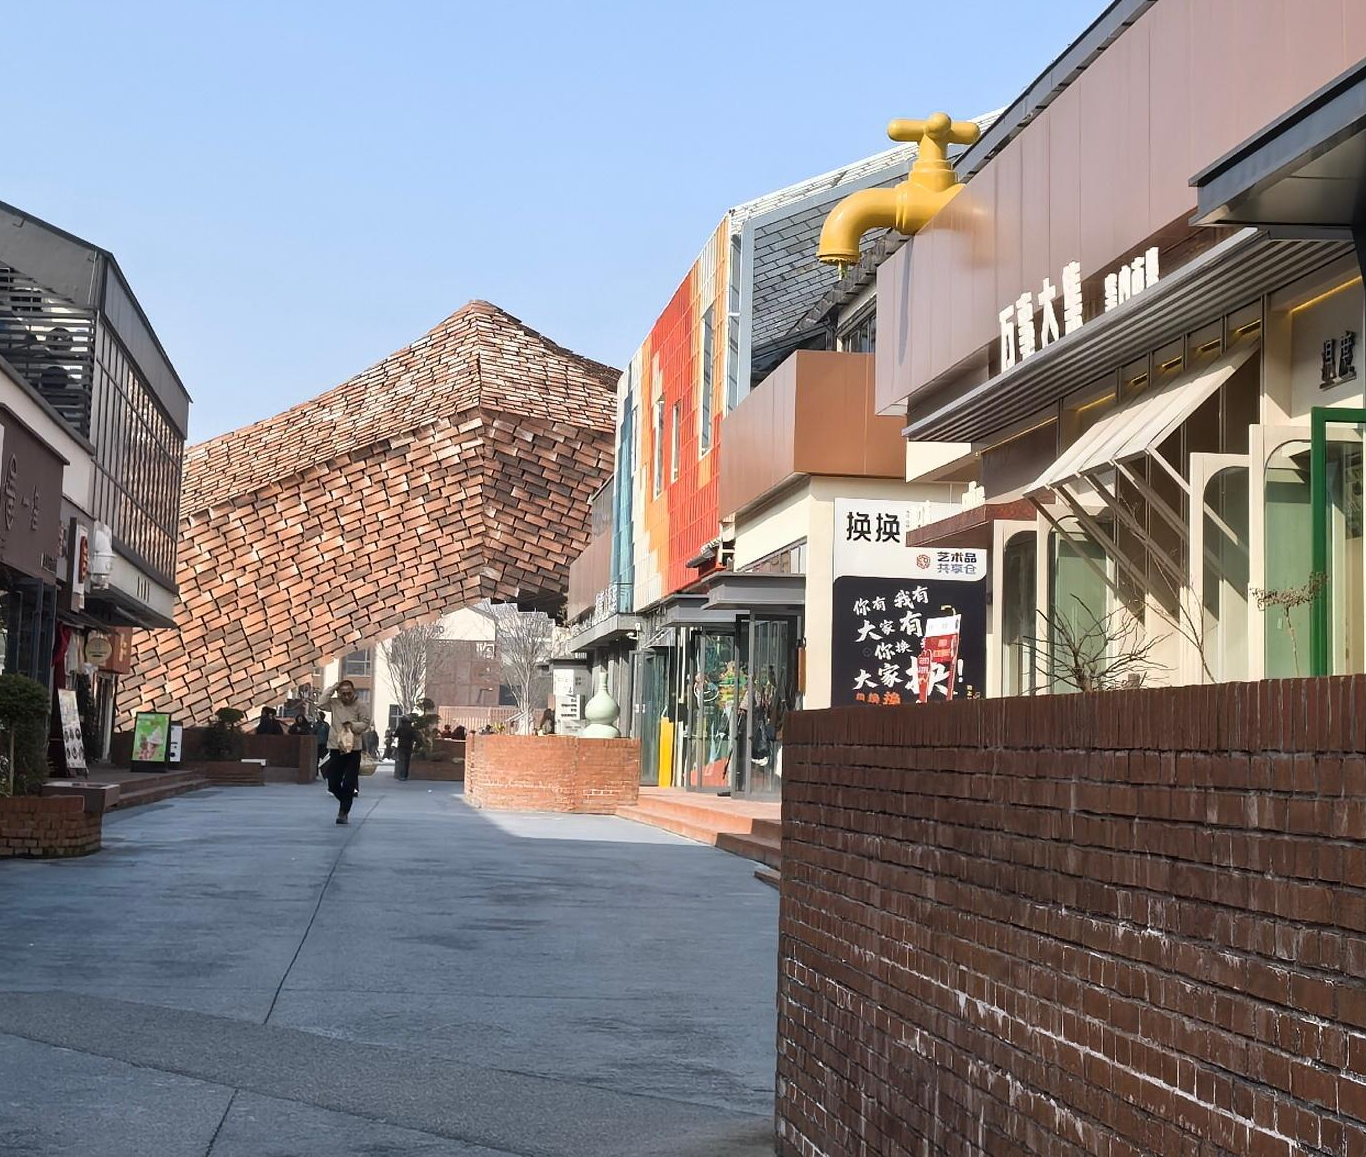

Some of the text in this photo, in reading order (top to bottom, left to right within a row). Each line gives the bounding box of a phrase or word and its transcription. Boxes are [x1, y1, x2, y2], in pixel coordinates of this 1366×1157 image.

[846, 511, 901, 543] 换换
[937, 551, 977, 563] 艺术品
[937, 563, 977, 575] 共享仓
[853, 585, 929, 616] 你有 我有
[855, 610, 924, 642] 大家有
